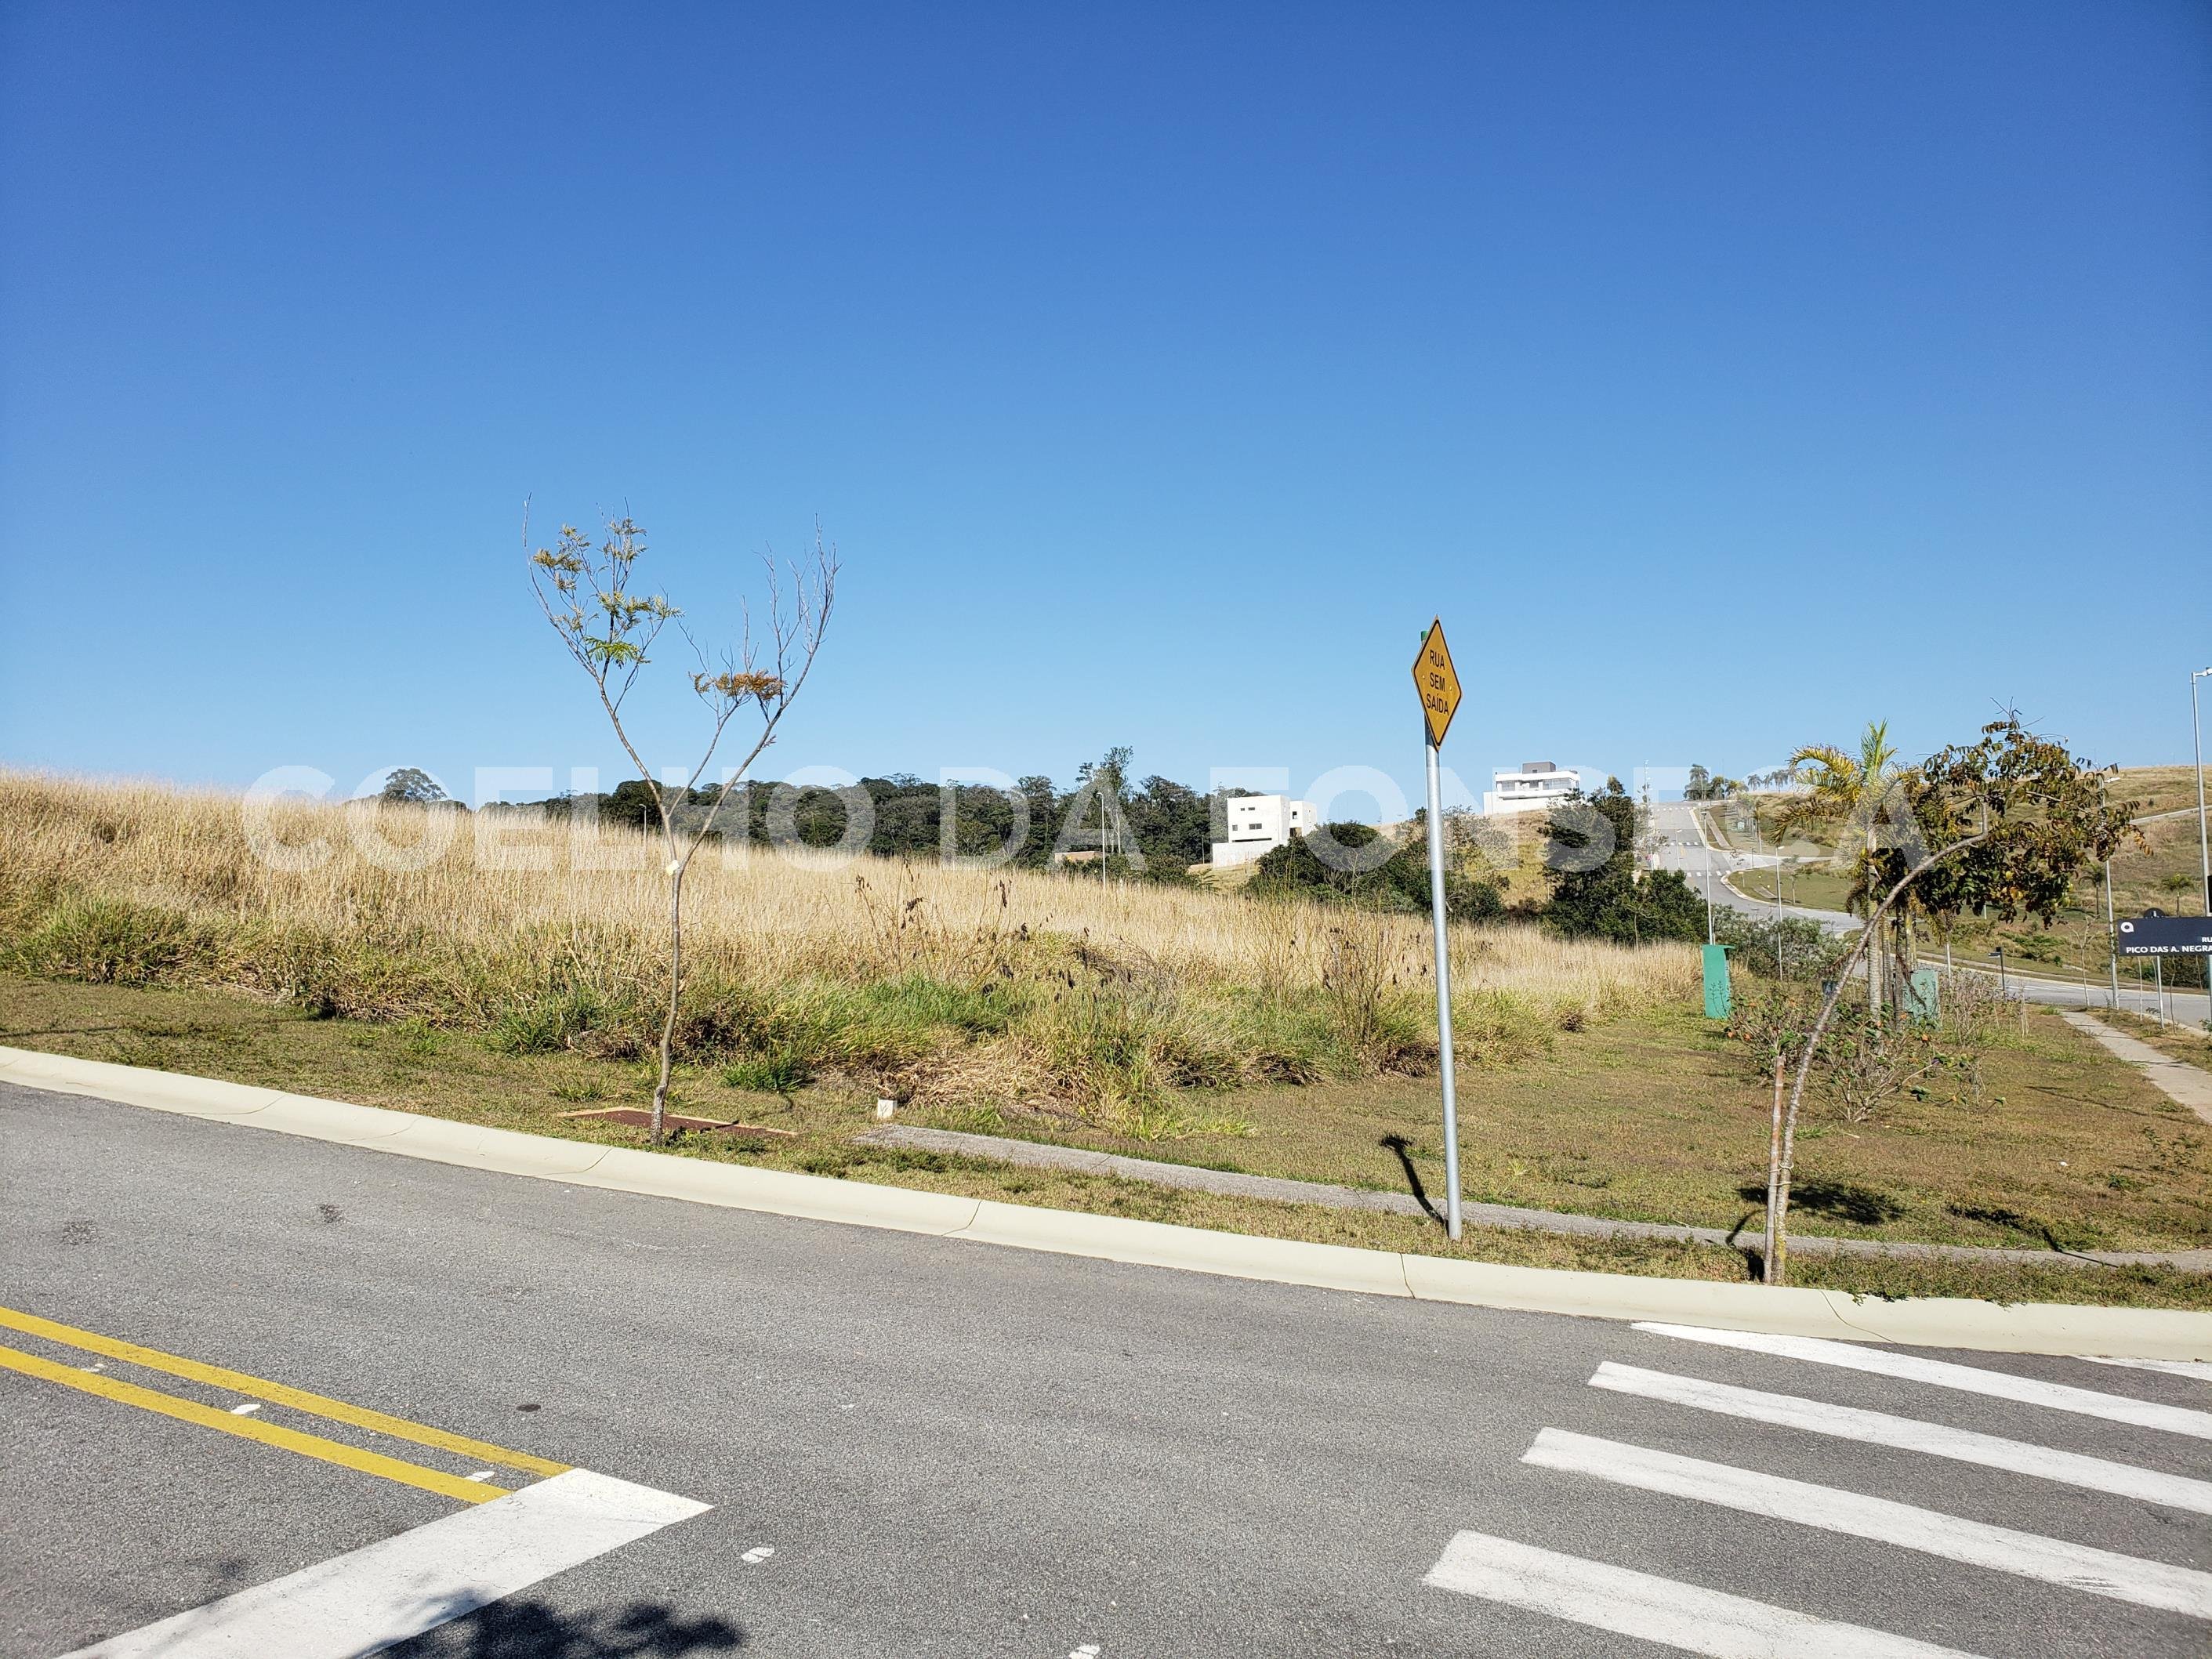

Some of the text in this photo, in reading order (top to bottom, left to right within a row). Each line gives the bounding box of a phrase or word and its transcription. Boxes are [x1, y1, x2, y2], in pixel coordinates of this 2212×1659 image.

[1430, 649, 1445, 670] RUA
[1430, 672, 1445, 692] SEM
[1426, 693, 1449, 715] SAÍDA
